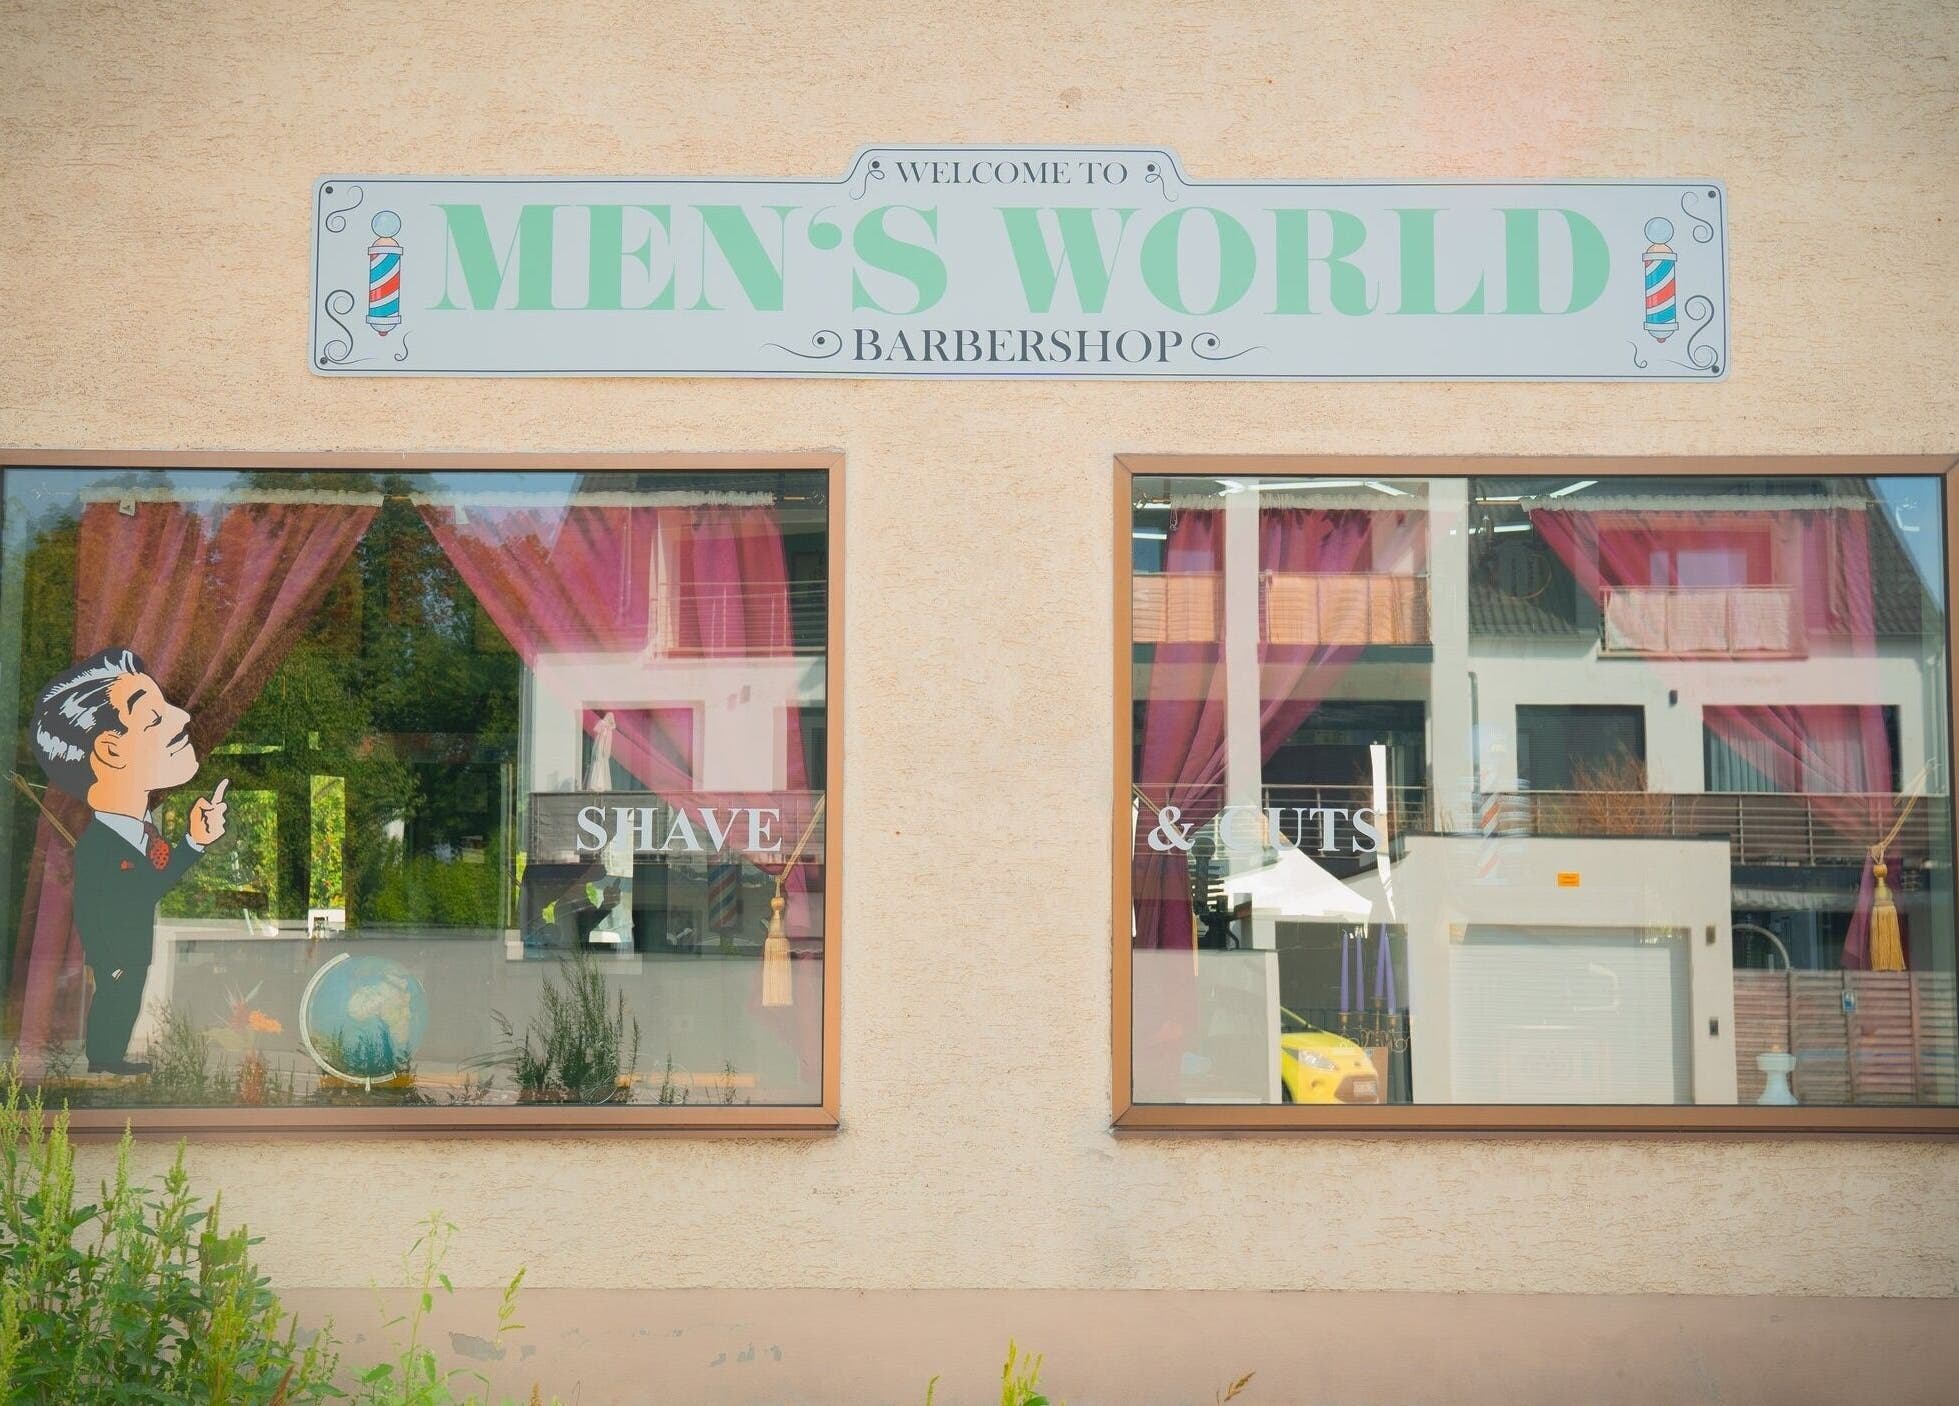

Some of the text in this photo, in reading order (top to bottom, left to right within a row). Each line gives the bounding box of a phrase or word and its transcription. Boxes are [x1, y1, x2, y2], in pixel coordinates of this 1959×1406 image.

[895, 161, 1128, 185] WELCOME TO
[993, 206, 1611, 316] WORLD
[852, 328, 1183, 363] BARBERSHOP
[576, 805, 782, 853] SHAVE
[1147, 805, 1379, 852] & CUTS
